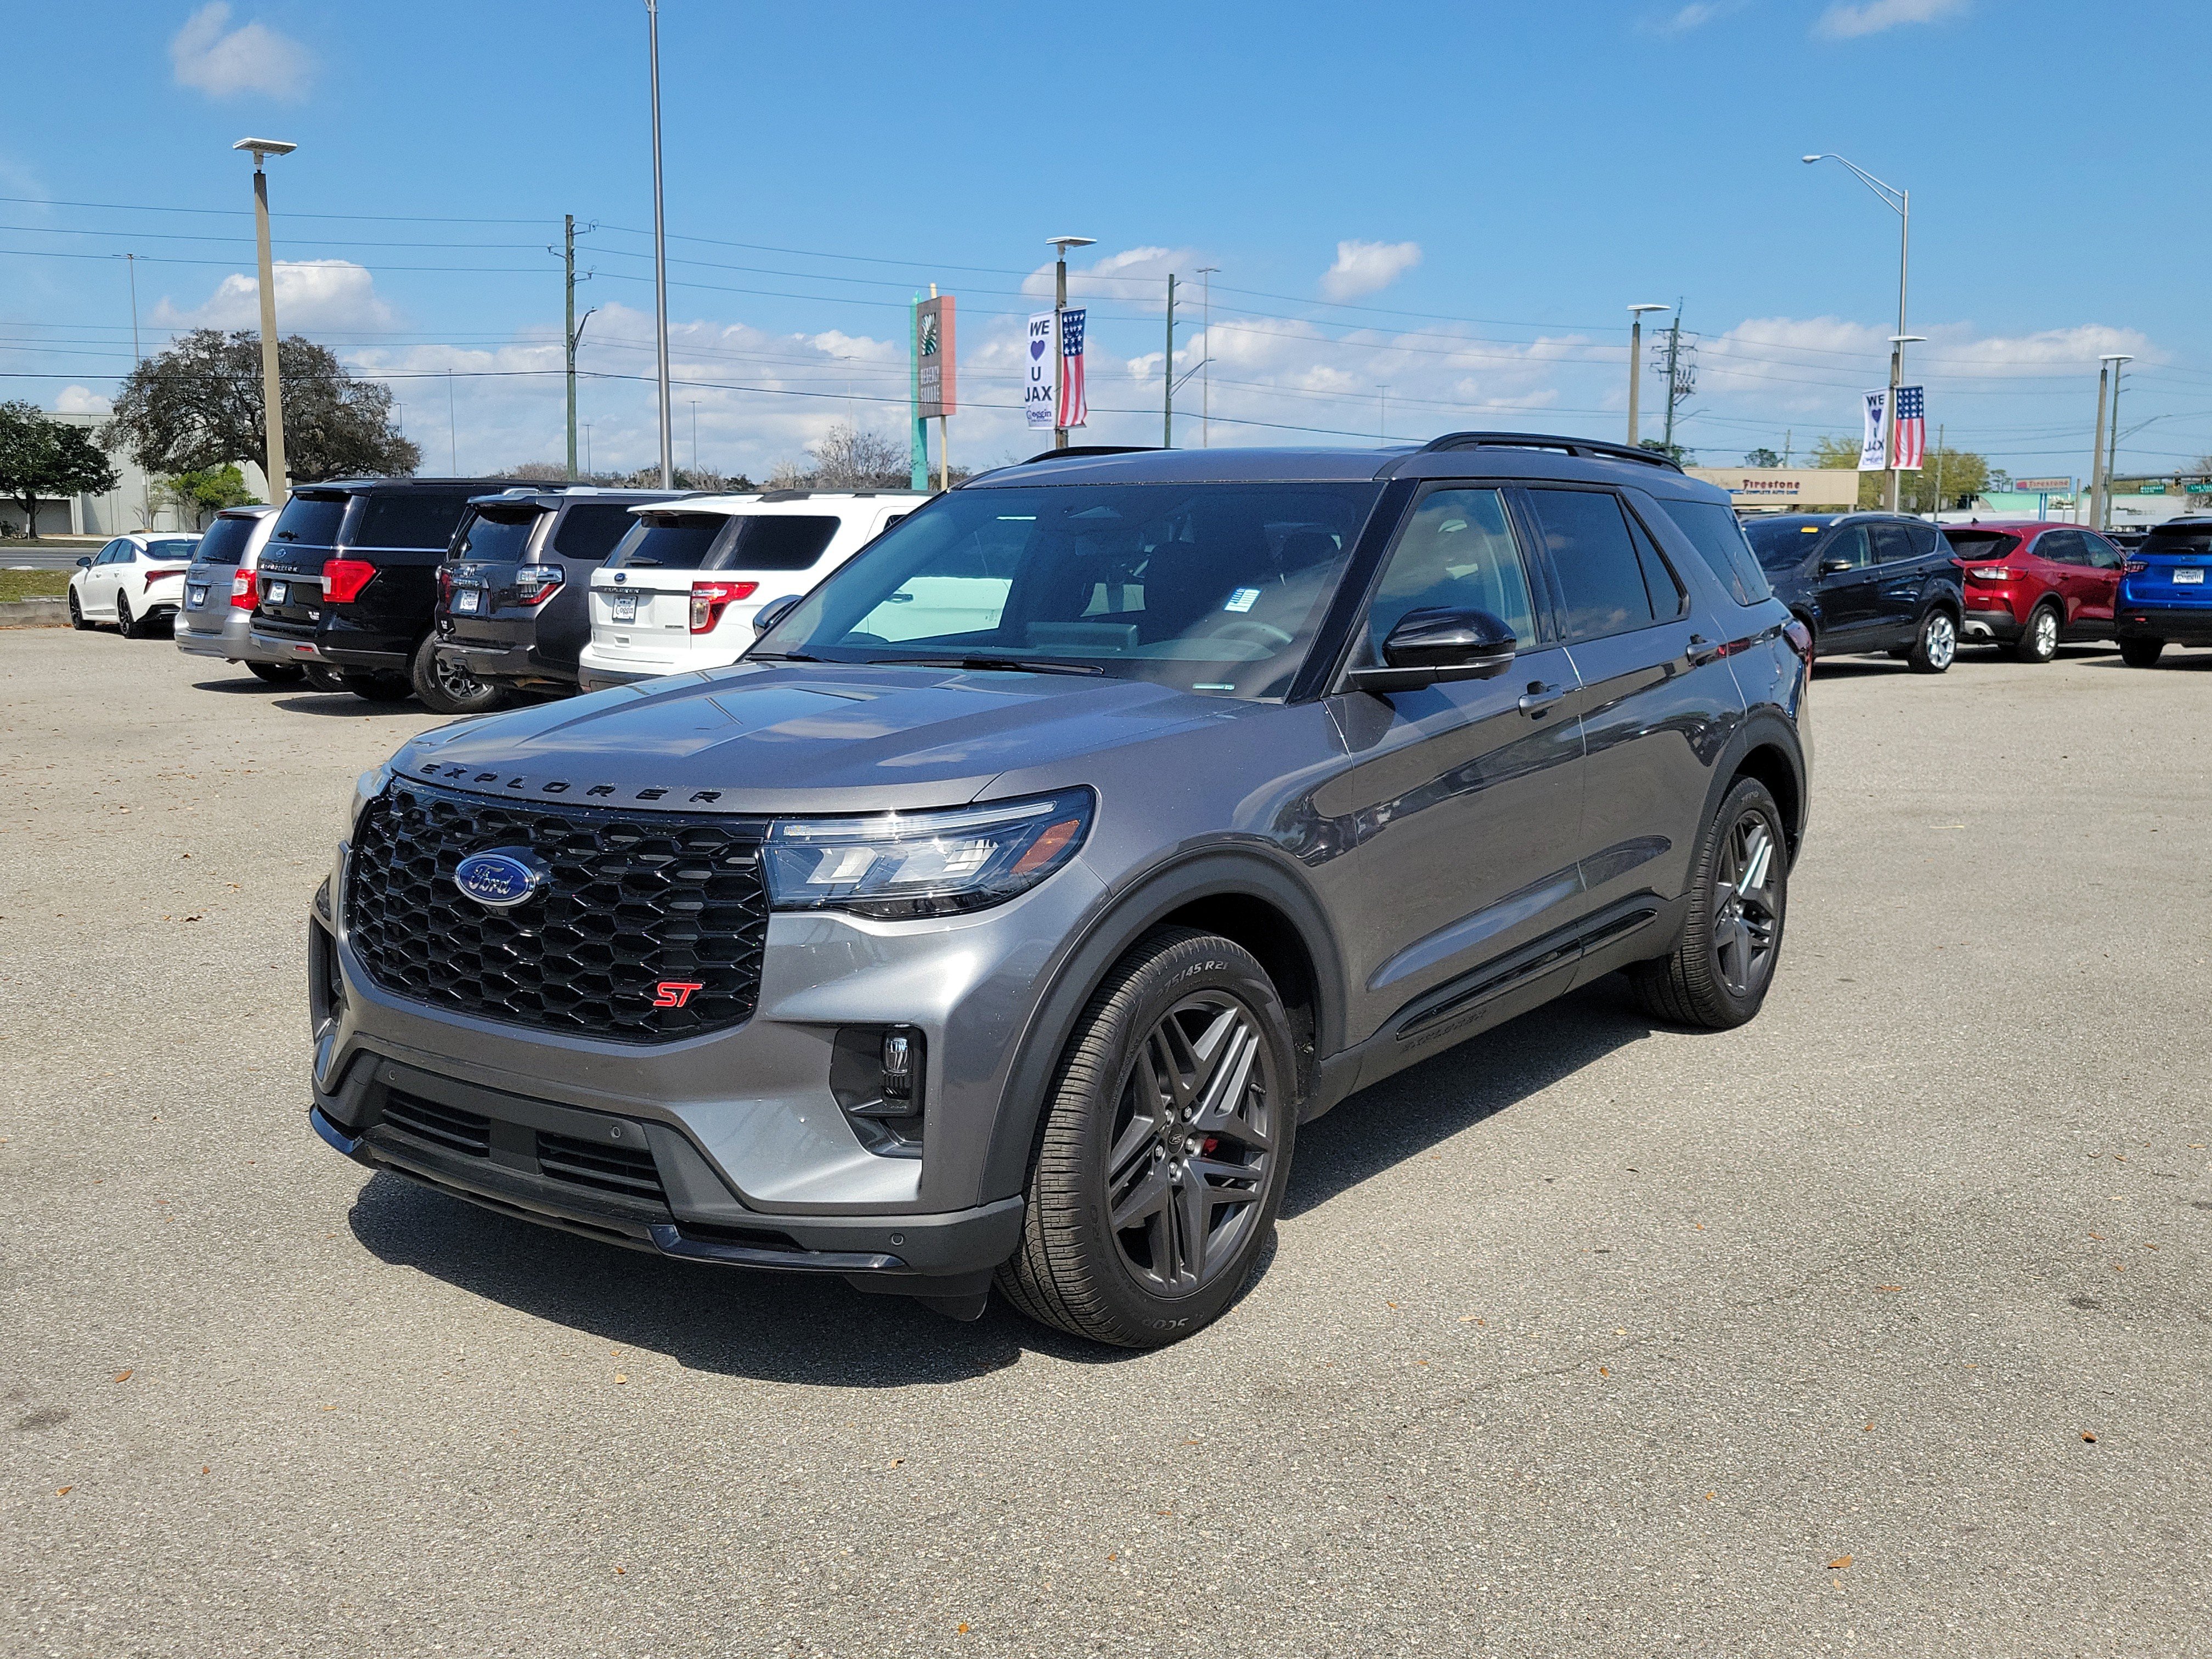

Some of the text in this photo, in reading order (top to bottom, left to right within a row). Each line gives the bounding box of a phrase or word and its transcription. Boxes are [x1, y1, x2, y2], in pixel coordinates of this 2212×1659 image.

[1030, 320, 1050, 337] WE
[1031, 366, 1041, 382] U
[1025, 386, 1053, 403] JAX
[1866, 394, 1885, 407] WE
[1026, 409, 1052, 420] Coggin
[1742, 479, 1800, 490] Firestone
[419, 763, 723, 804] EXPLORER
[469, 864, 514, 895] Ford
[653, 982, 703, 1007] ST
